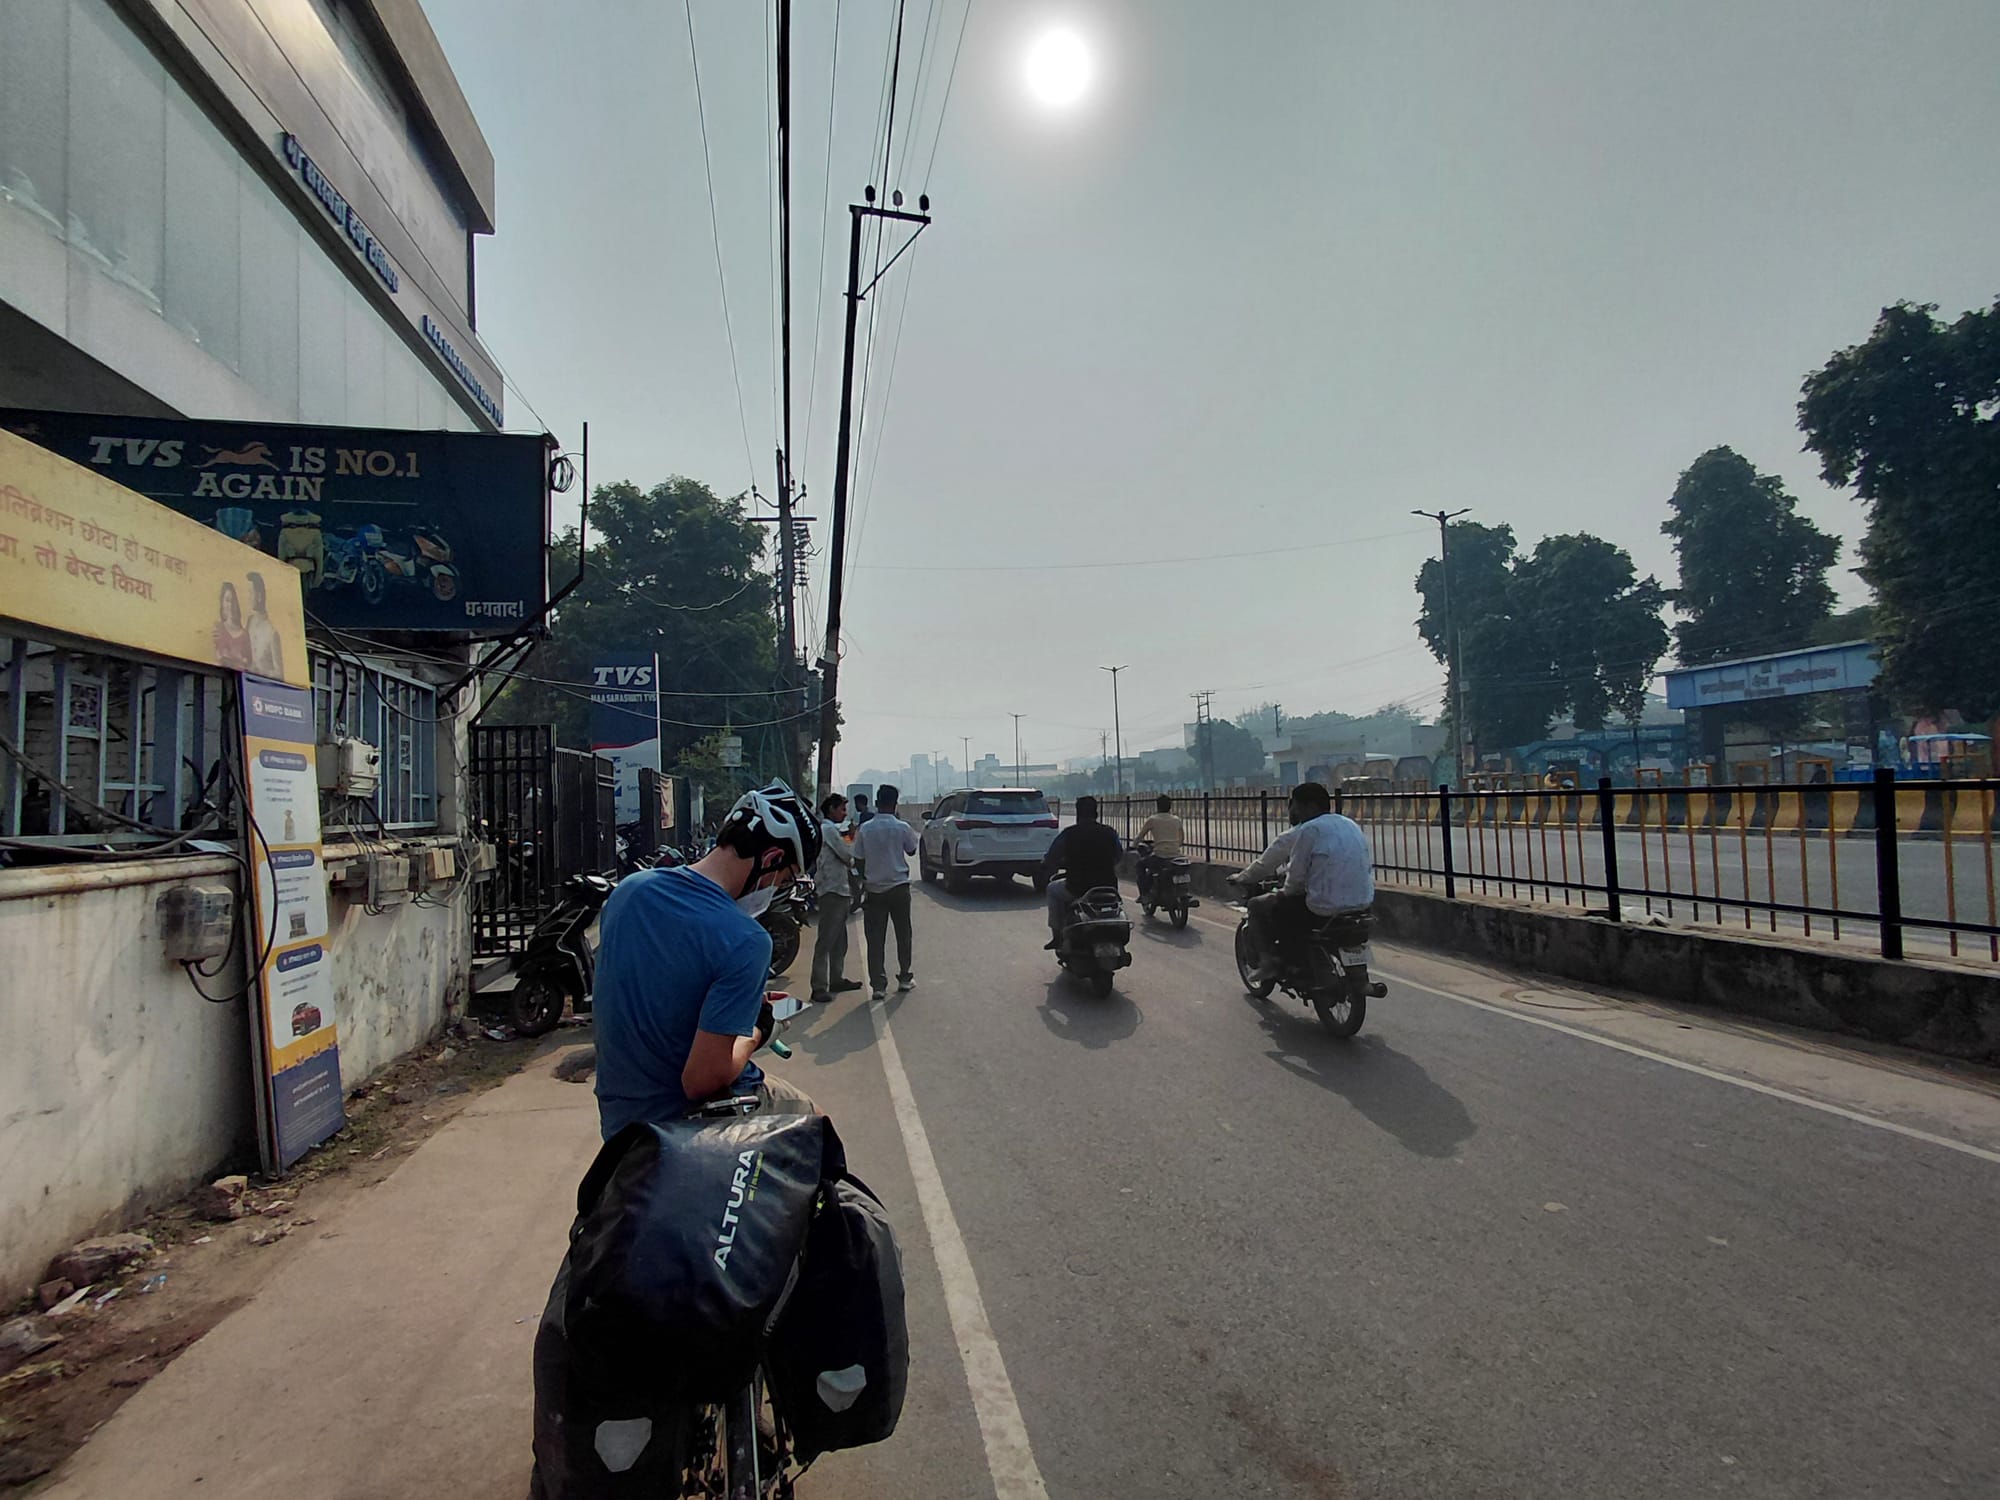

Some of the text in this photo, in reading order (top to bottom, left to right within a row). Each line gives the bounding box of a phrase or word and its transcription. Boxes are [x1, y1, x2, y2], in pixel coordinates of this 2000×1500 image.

[88, 436, 420, 478] TVS IS NO.1
[192, 472, 325, 502] AGAIN
[80, 517, 118, 552] छोटा
[33, 540, 57, 570] तो
[64, 548, 106, 585] बेस्ट
[465, 600, 524, 617] धन्यवाद!
[593, 666, 652, 686] TVS
[713, 1149, 756, 1271] ALTURA
